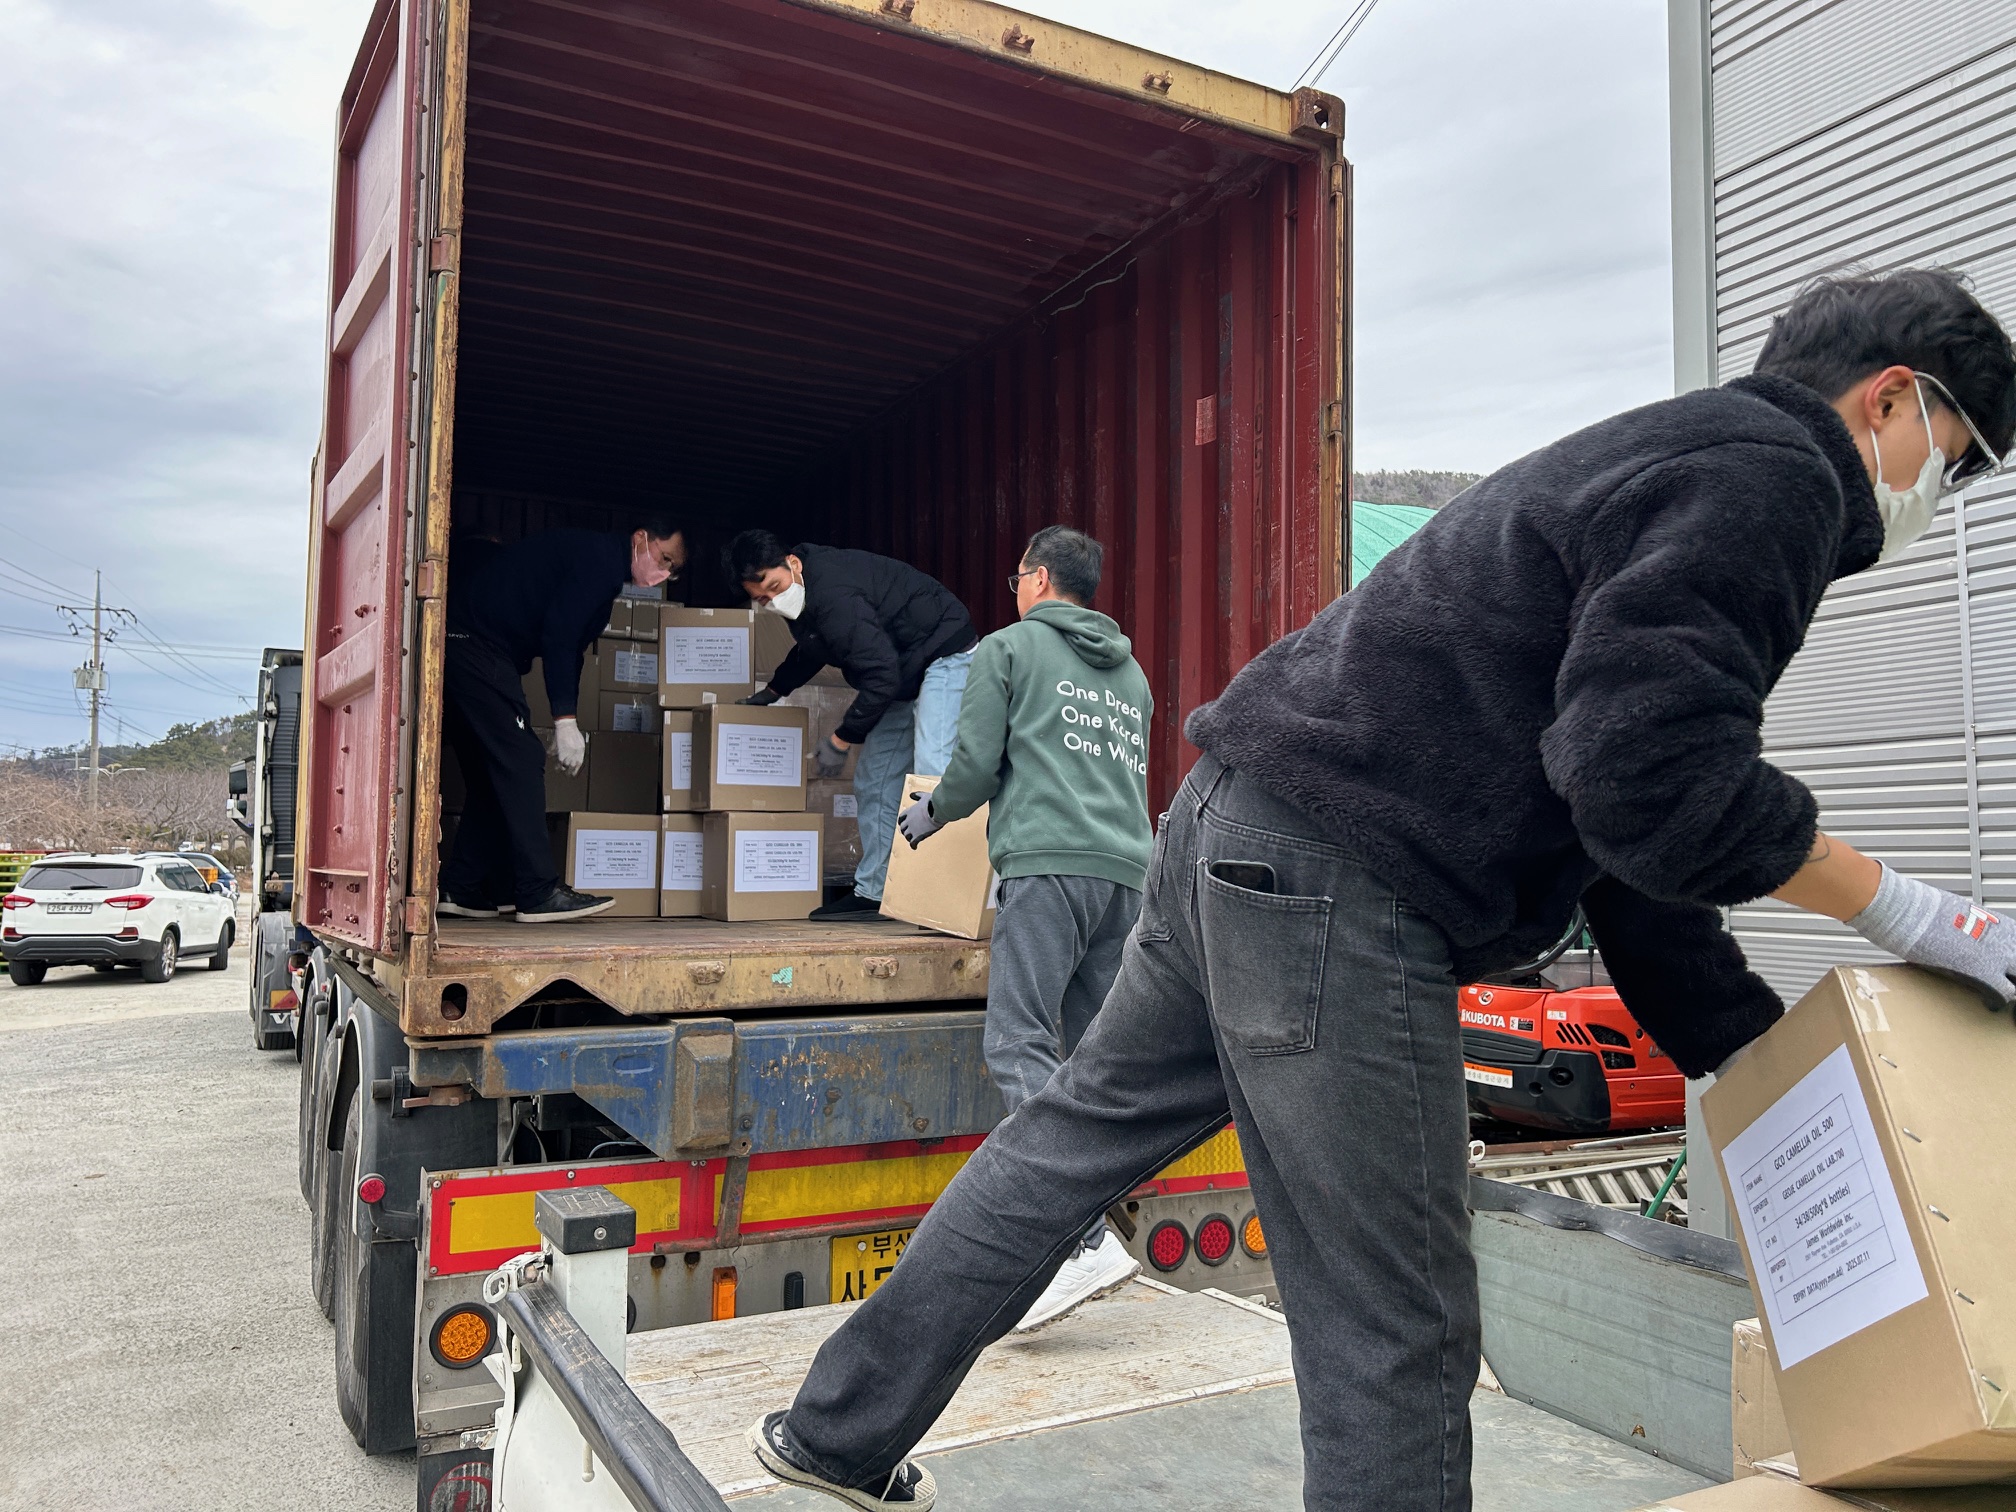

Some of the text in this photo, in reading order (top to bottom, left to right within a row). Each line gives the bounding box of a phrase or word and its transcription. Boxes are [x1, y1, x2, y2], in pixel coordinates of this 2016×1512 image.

[1056, 680, 1099, 702] One
[1061, 705, 1103, 729] One
[1063, 732, 1102, 757] One
[1462, 1009, 1506, 1029] KUBOTA
[1774, 1116, 1833, 1170] GCO CAMELLIA OIL 500
[1782, 1184, 1796, 1200] GEOJE
[1795, 1169, 1816, 1190] CAMELLIA
[1816, 1163, 1825, 1174] OIL
[1828, 1183, 1850, 1205] bottles)
[1806, 1235, 1819, 1248] James
[1819, 1218, 1843, 1238] Worldwide
[1793, 1289, 1806, 1303] EXPIRY
[1846, 1251, 1870, 1271] 2025.07.11
